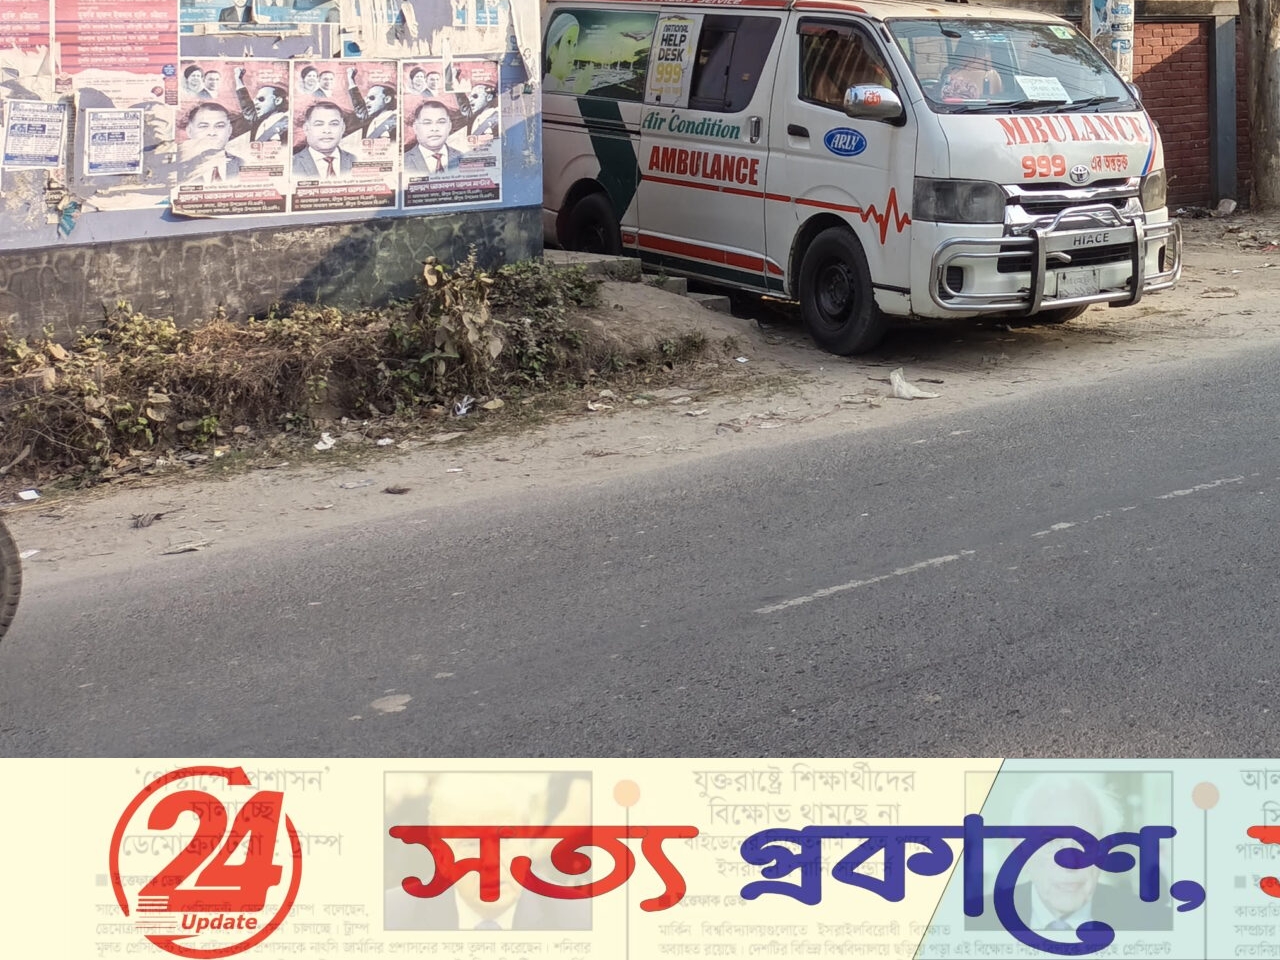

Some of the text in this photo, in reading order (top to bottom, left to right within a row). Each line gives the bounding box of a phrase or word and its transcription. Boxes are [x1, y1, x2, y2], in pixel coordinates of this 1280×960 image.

[663, 24, 689, 33] NATIONAL
[661, 34, 687, 47] HELP
[658, 48, 685, 62] DESK
[655, 63, 682, 84] 999
[641, 112, 741, 140] Air Condition
[995, 115, 1149, 146] MBULANCE
[830, 133, 859, 151] ARLY
[648, 145, 760, 186] AMBULANCE
[1021, 154, 1067, 179] 999
[1073, 232, 1110, 246] HIACE
